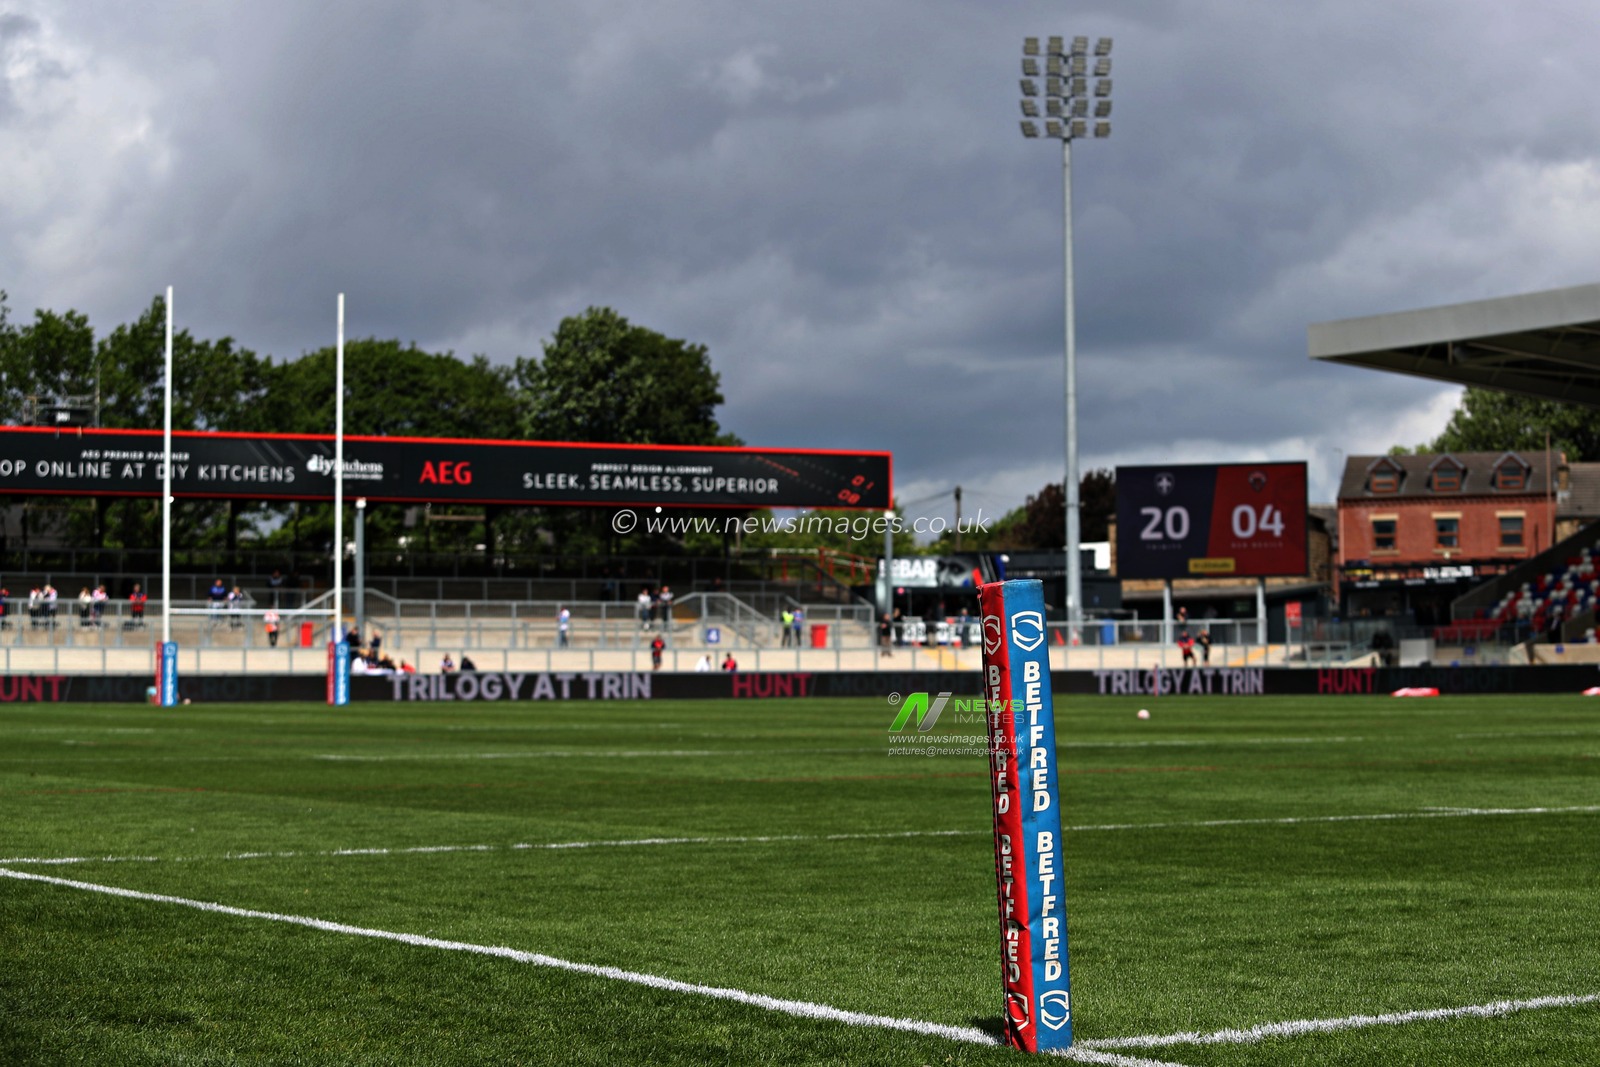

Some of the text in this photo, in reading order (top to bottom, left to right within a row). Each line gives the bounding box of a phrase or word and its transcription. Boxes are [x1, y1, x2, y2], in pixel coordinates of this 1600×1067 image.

[35, 460, 112, 479] ONLINE
[121, 462, 146, 480] AT
[155, 463, 189, 481] DIY
[197, 464, 296, 484] KITCHENS
[419, 460, 472, 486] AEG
[523, 472, 779, 495] SLEEK, SEAMLESS, SUPERIOR
[1140, 506, 1190, 541] 20
[1232, 504, 1285, 539] 04
[387, 672, 527, 700] TRILOGY
[532, 673, 577, 699] AT
[581, 673, 652, 699] TRIN
[731, 673, 812, 698] HUNT
[1093, 669, 1185, 695] TRILOGY
[1189, 669, 1216, 694] AT
[1219, 668, 1264, 694] TRIN
[1317, 668, 1376, 694] HUNT
[1023, 661, 1051, 813] BETFRED
[1001, 834, 1021, 983] BETFRED
[1037, 831, 1062, 982] BETFRED
